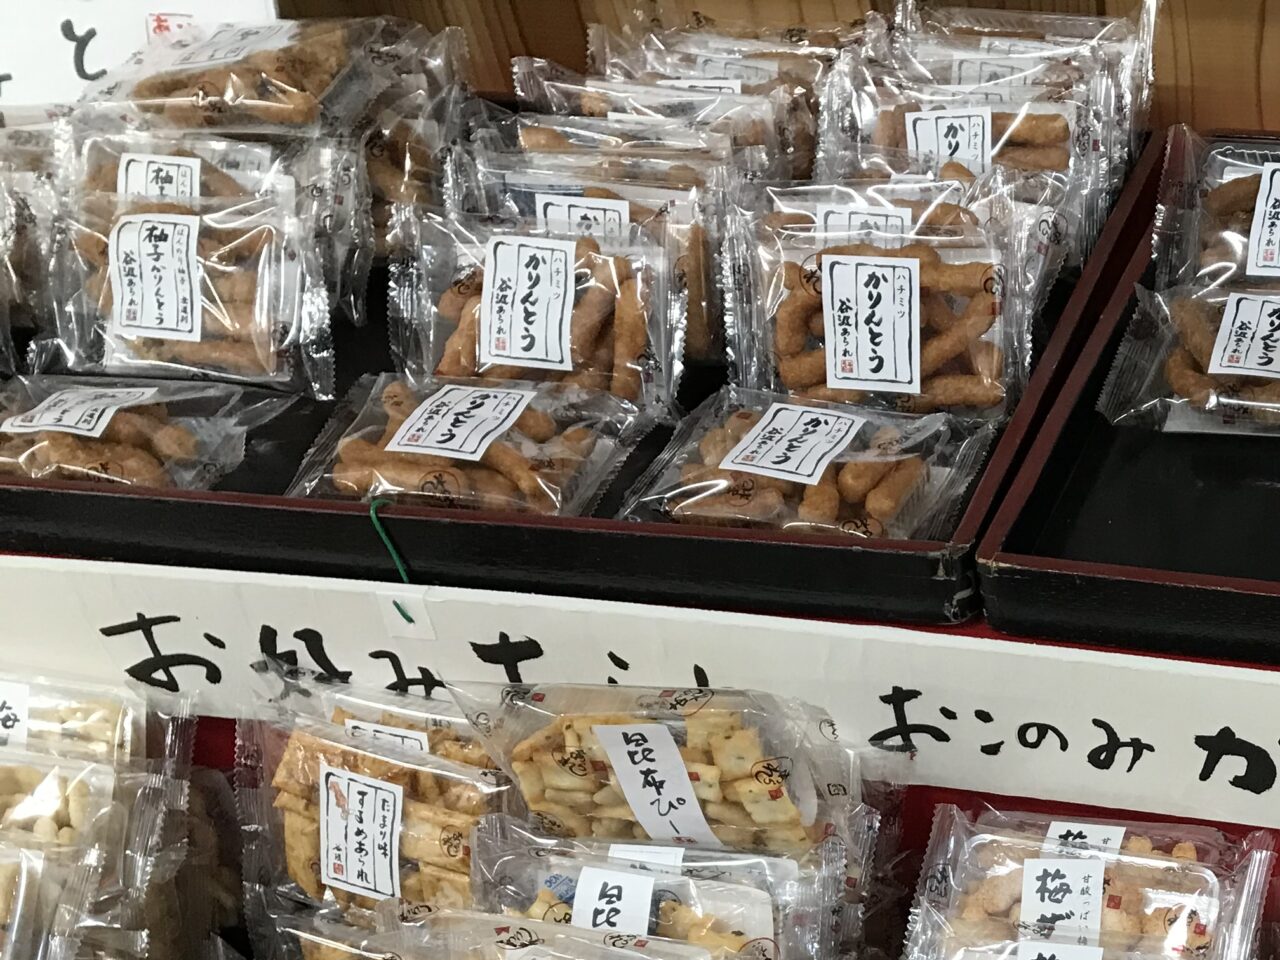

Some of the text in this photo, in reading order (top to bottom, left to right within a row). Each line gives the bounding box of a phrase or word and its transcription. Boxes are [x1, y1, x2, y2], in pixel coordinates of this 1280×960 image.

[143, 224, 169, 325] 柚子かりんとう
[520, 253, 546, 352] かりんとう
[553, 257, 562, 300] ハチミツ
[897, 275, 906, 319] ハチミツ
[864, 272, 888, 373] かりんとう
[436, 393, 498, 444] かりんとう
[771, 417, 829, 465] かりんとう
[868, 685, 1156, 774] おこのみ
[622, 732, 686, 835] 昆布ぴー
[354, 790, 371, 884] するめあられ
